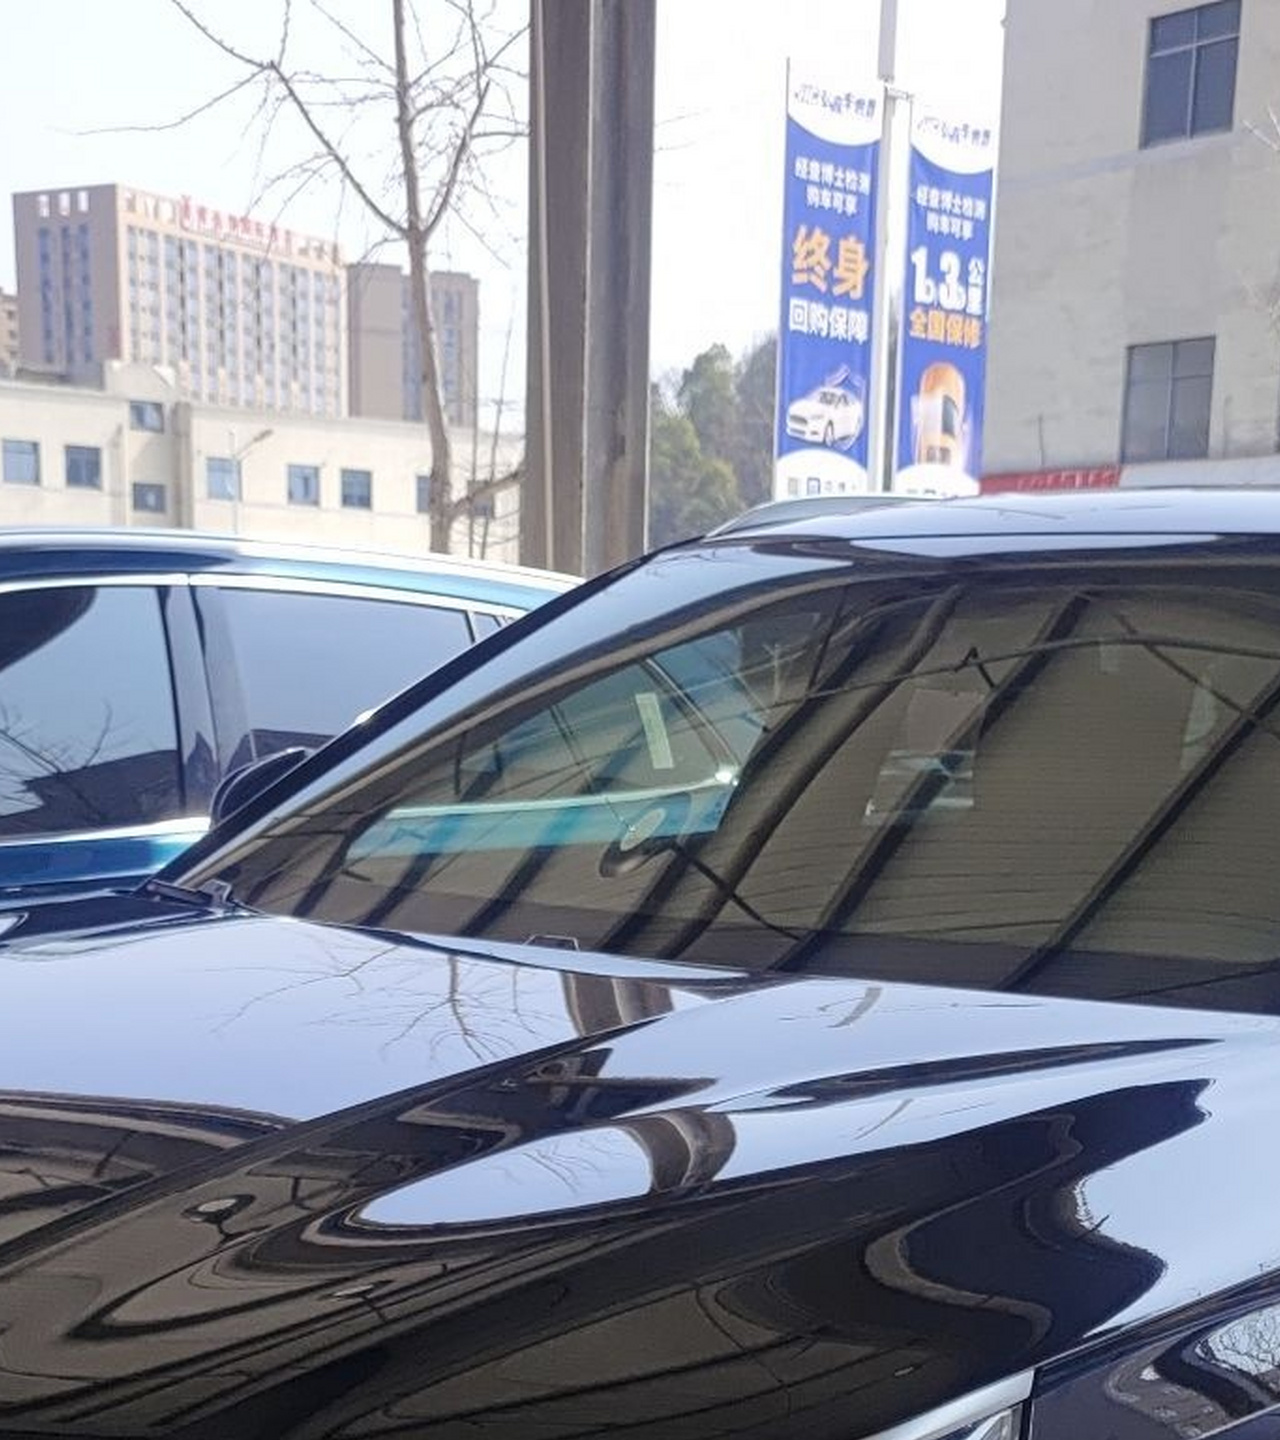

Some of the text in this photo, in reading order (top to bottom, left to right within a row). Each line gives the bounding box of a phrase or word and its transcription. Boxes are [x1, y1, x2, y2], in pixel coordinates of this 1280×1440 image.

[792, 224, 869, 300] 终身
[789, 297, 868, 344] 回购保障
